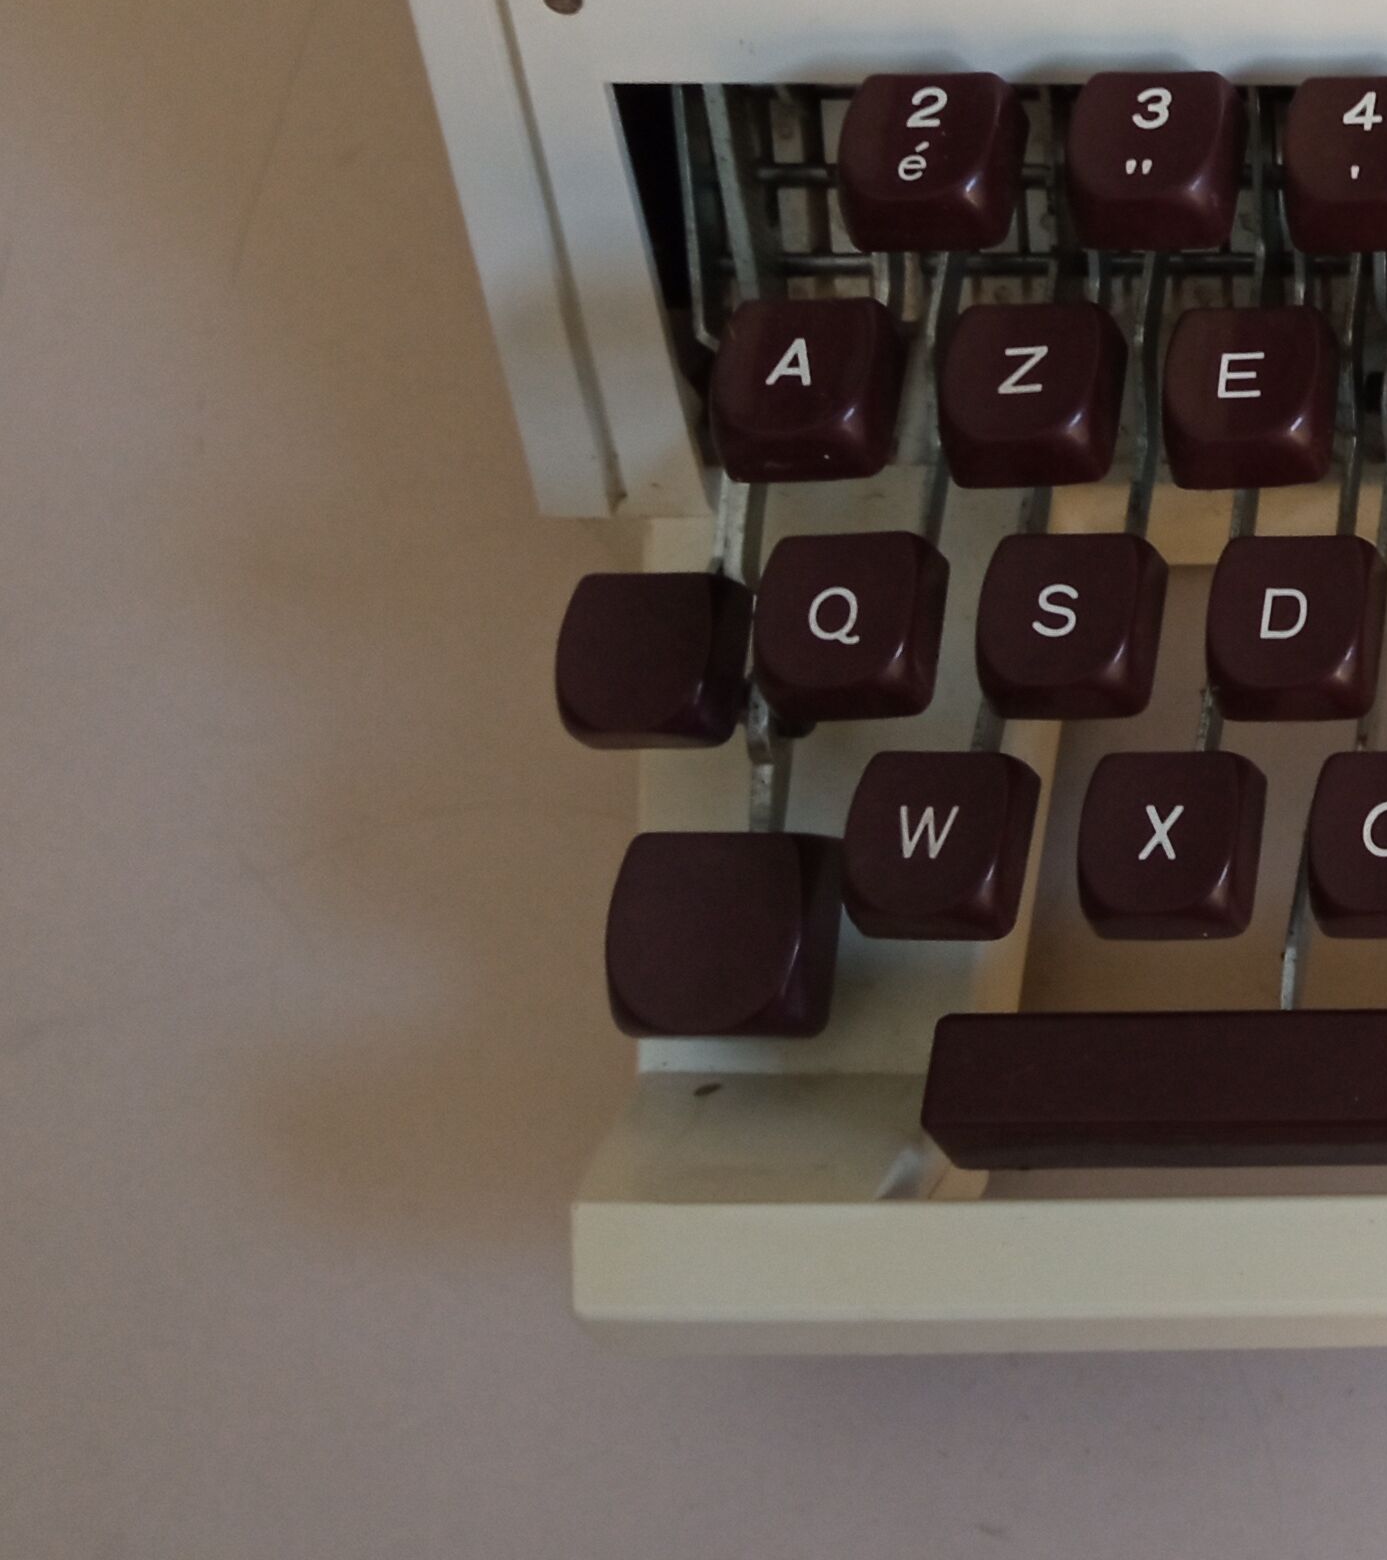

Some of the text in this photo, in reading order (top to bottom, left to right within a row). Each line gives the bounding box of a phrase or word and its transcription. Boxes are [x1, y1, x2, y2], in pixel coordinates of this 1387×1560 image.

[906, 86, 948, 128] 2
[1132, 87, 1172, 130] 3
[1342, 91, 1383, 131] 4
[897, 141, 930, 181] é
[765, 337, 812, 386] A
[997, 345, 1049, 395] Z
[1217, 351, 1265, 399] E
[808, 586, 860, 645] Q
[1031, 583, 1079, 638] S
[1259, 587, 1308, 639] D
[899, 805, 960, 859] W
[1138, 804, 1185, 861] X
